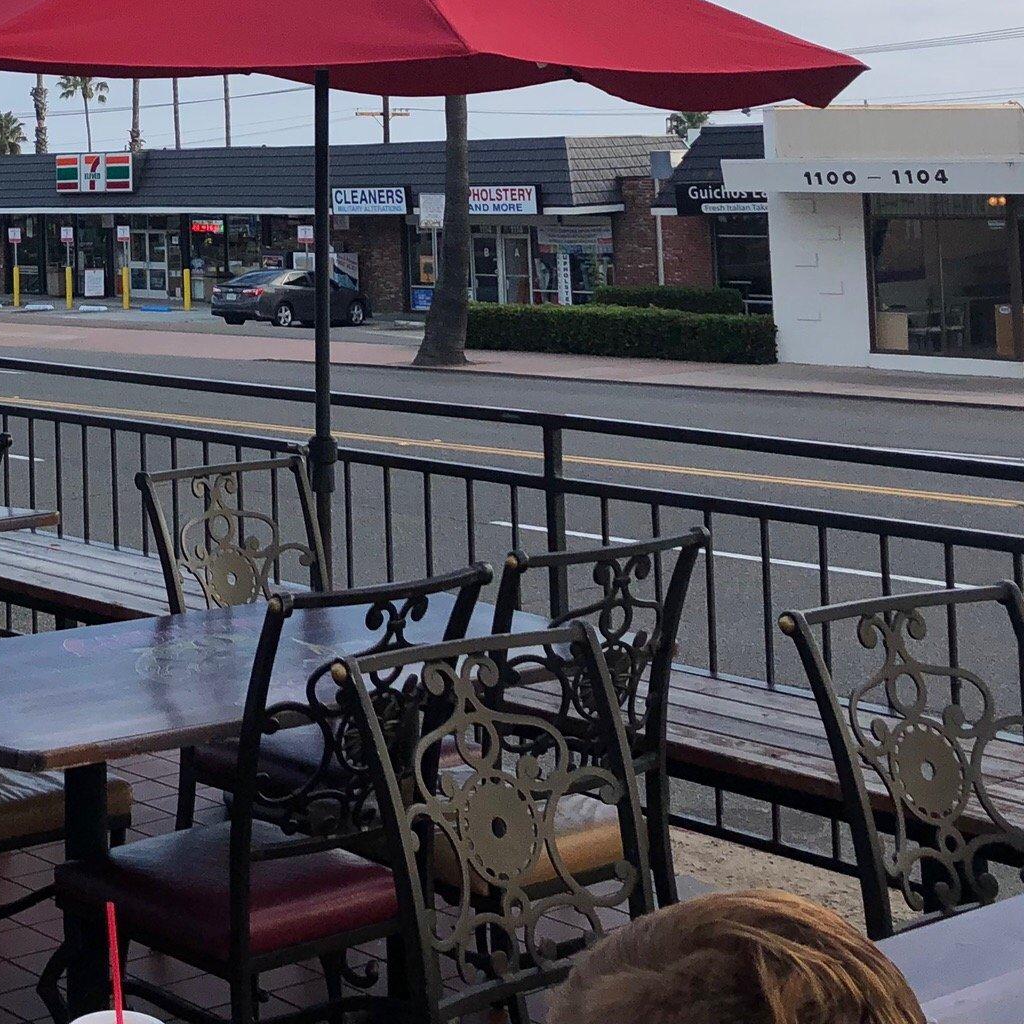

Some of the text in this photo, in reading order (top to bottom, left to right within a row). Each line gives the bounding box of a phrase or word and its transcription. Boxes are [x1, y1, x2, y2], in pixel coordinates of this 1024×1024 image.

[85, 156, 100, 190] 7
[803, 171, 856, 185] 1100
[891, 169, 949, 184] 1104
[334, 189, 403, 204] CLEANERS
